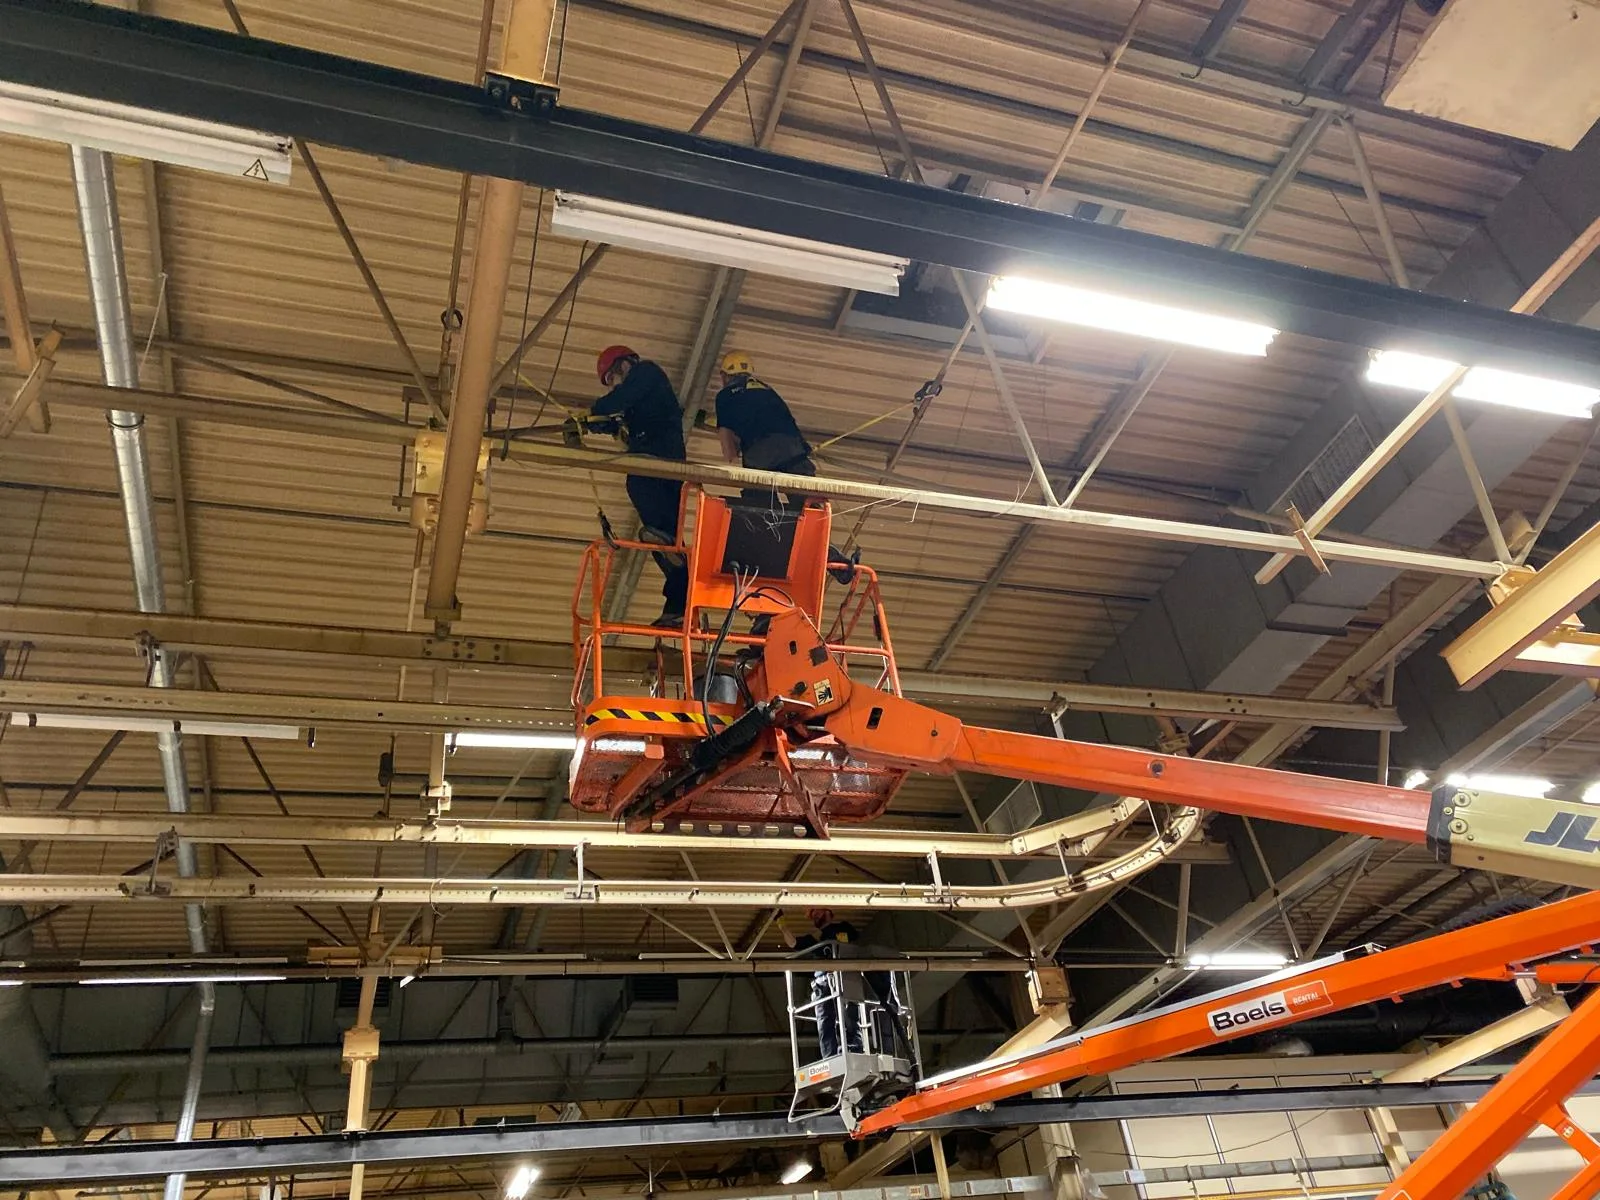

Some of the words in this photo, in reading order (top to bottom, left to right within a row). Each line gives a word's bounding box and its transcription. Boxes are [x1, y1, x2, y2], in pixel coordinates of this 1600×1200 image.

[1523, 811, 1600, 853] JL
[1212, 1000, 1286, 1031] Boels
[1292, 991, 1321, 1006] RENTAL
